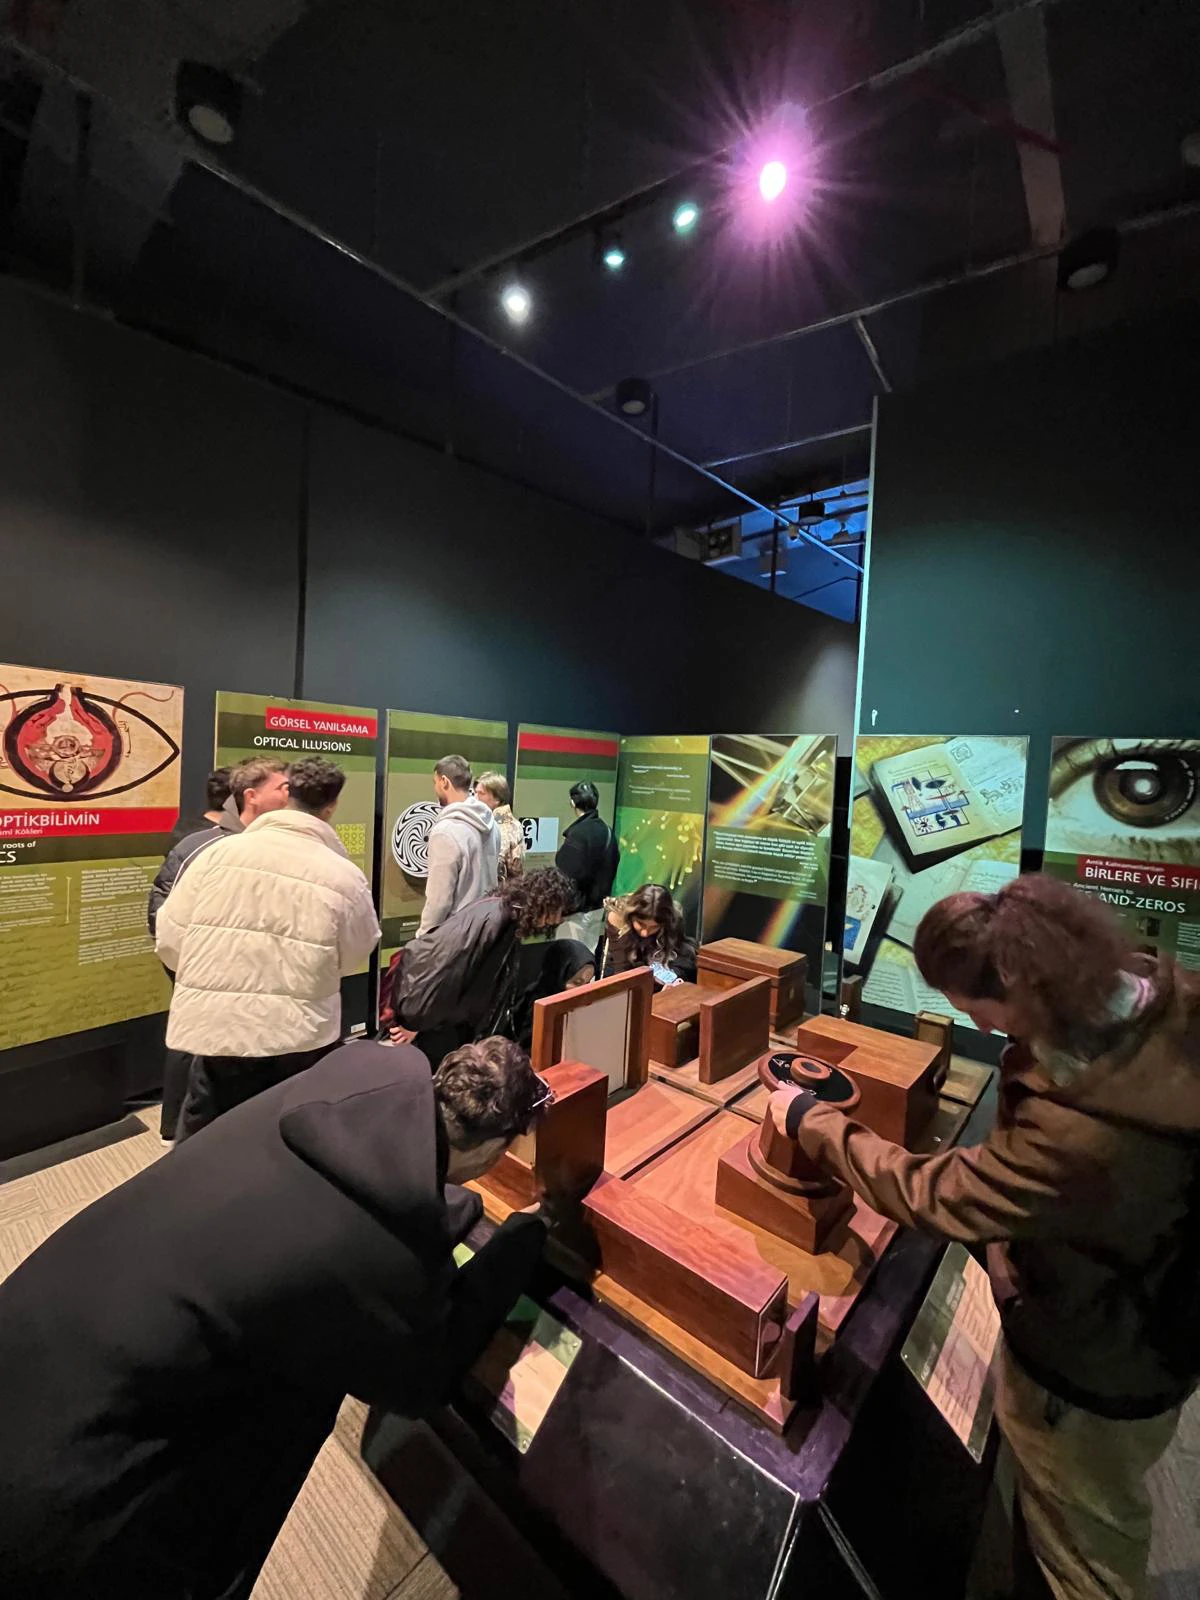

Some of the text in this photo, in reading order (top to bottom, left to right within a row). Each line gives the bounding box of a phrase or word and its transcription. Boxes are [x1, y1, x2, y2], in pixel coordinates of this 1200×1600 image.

[270, 715, 369, 734] GÖRSEL YANILSAMA
[253, 736, 351, 752] OPTICAL ILLUSIONS
[0, 812, 100, 827] PTİKBİLİMİN
[27, 840, 36, 848] of
[1085, 866, 1200, 890] BİRLERE VE SIFI
